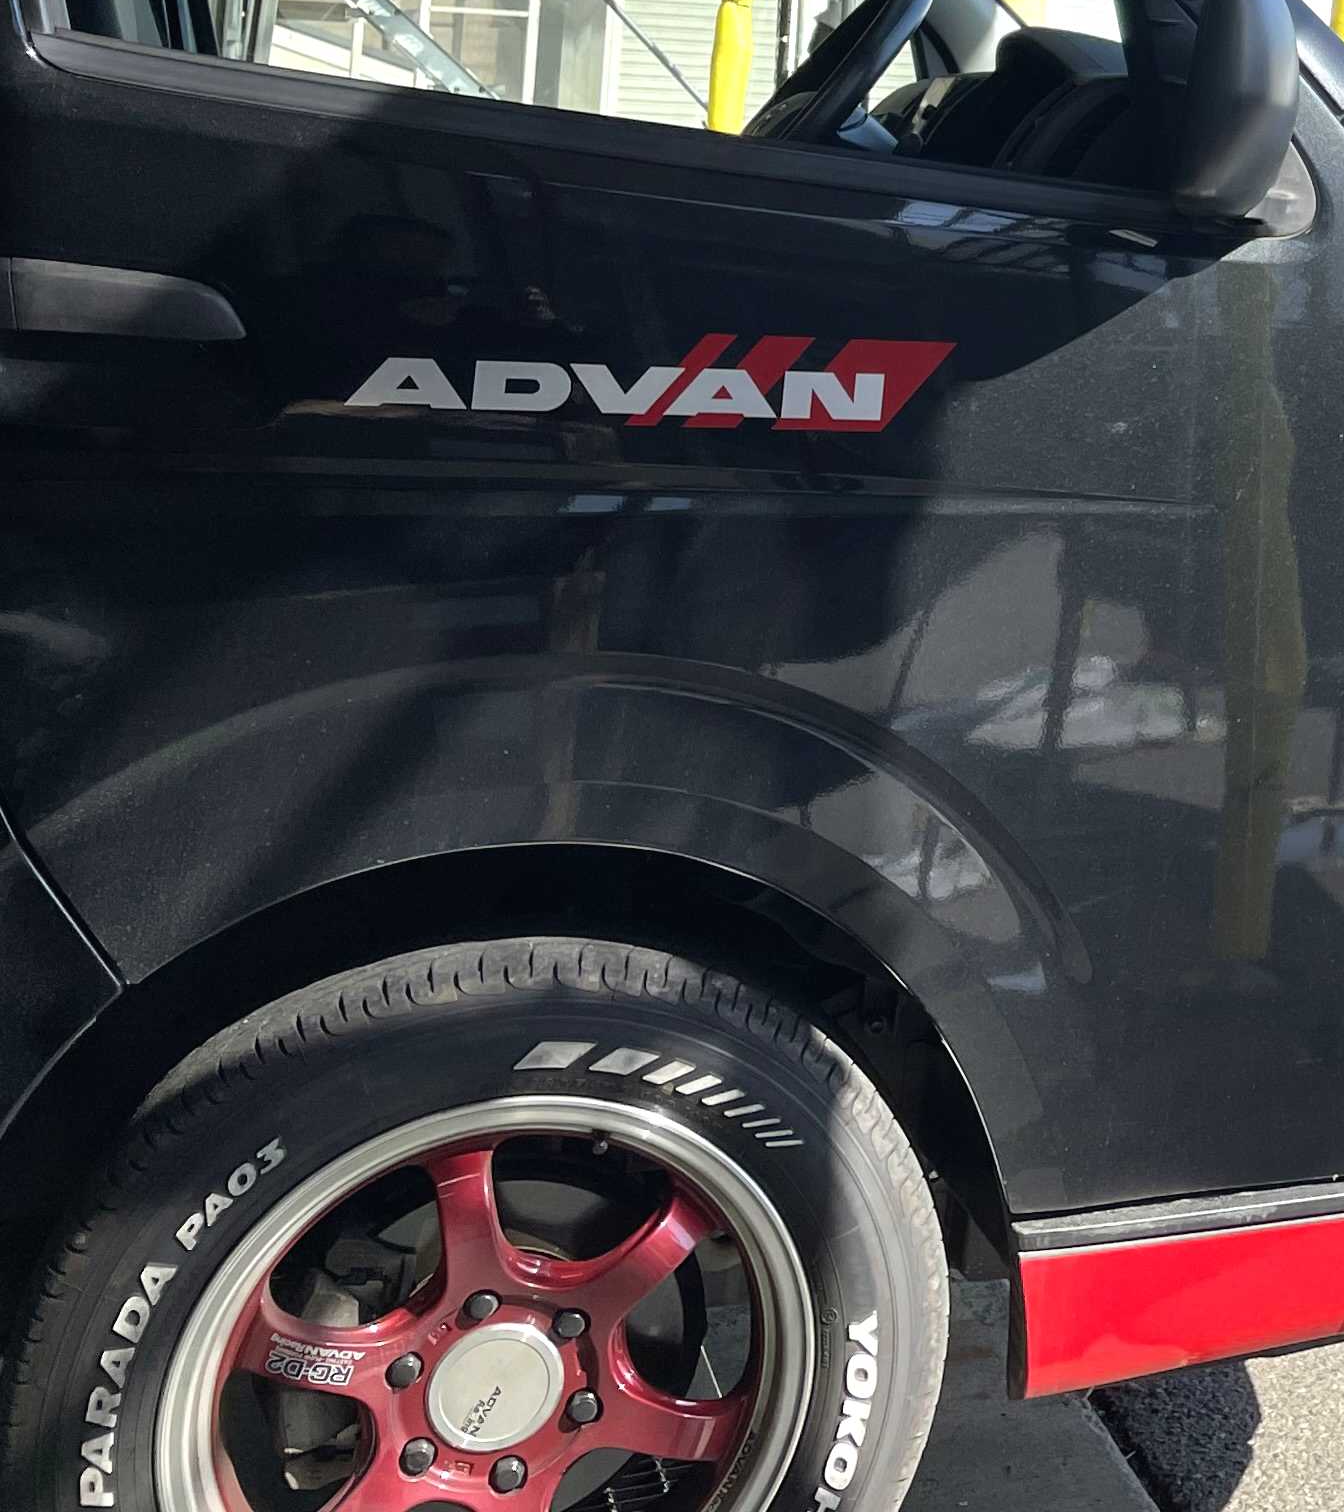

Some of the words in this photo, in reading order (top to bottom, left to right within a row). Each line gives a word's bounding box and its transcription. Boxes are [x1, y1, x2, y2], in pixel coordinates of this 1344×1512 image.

[342, 356, 887, 422] ADVAN
[265, 1350, 354, 1386] RG-D2
[304, 1345, 366, 1360] ADVAN
[79, 1262, 178, 1508] PARADA
[461, 1399, 486, 1434] Raing
[469, 1386, 502, 1437] ADVAN
